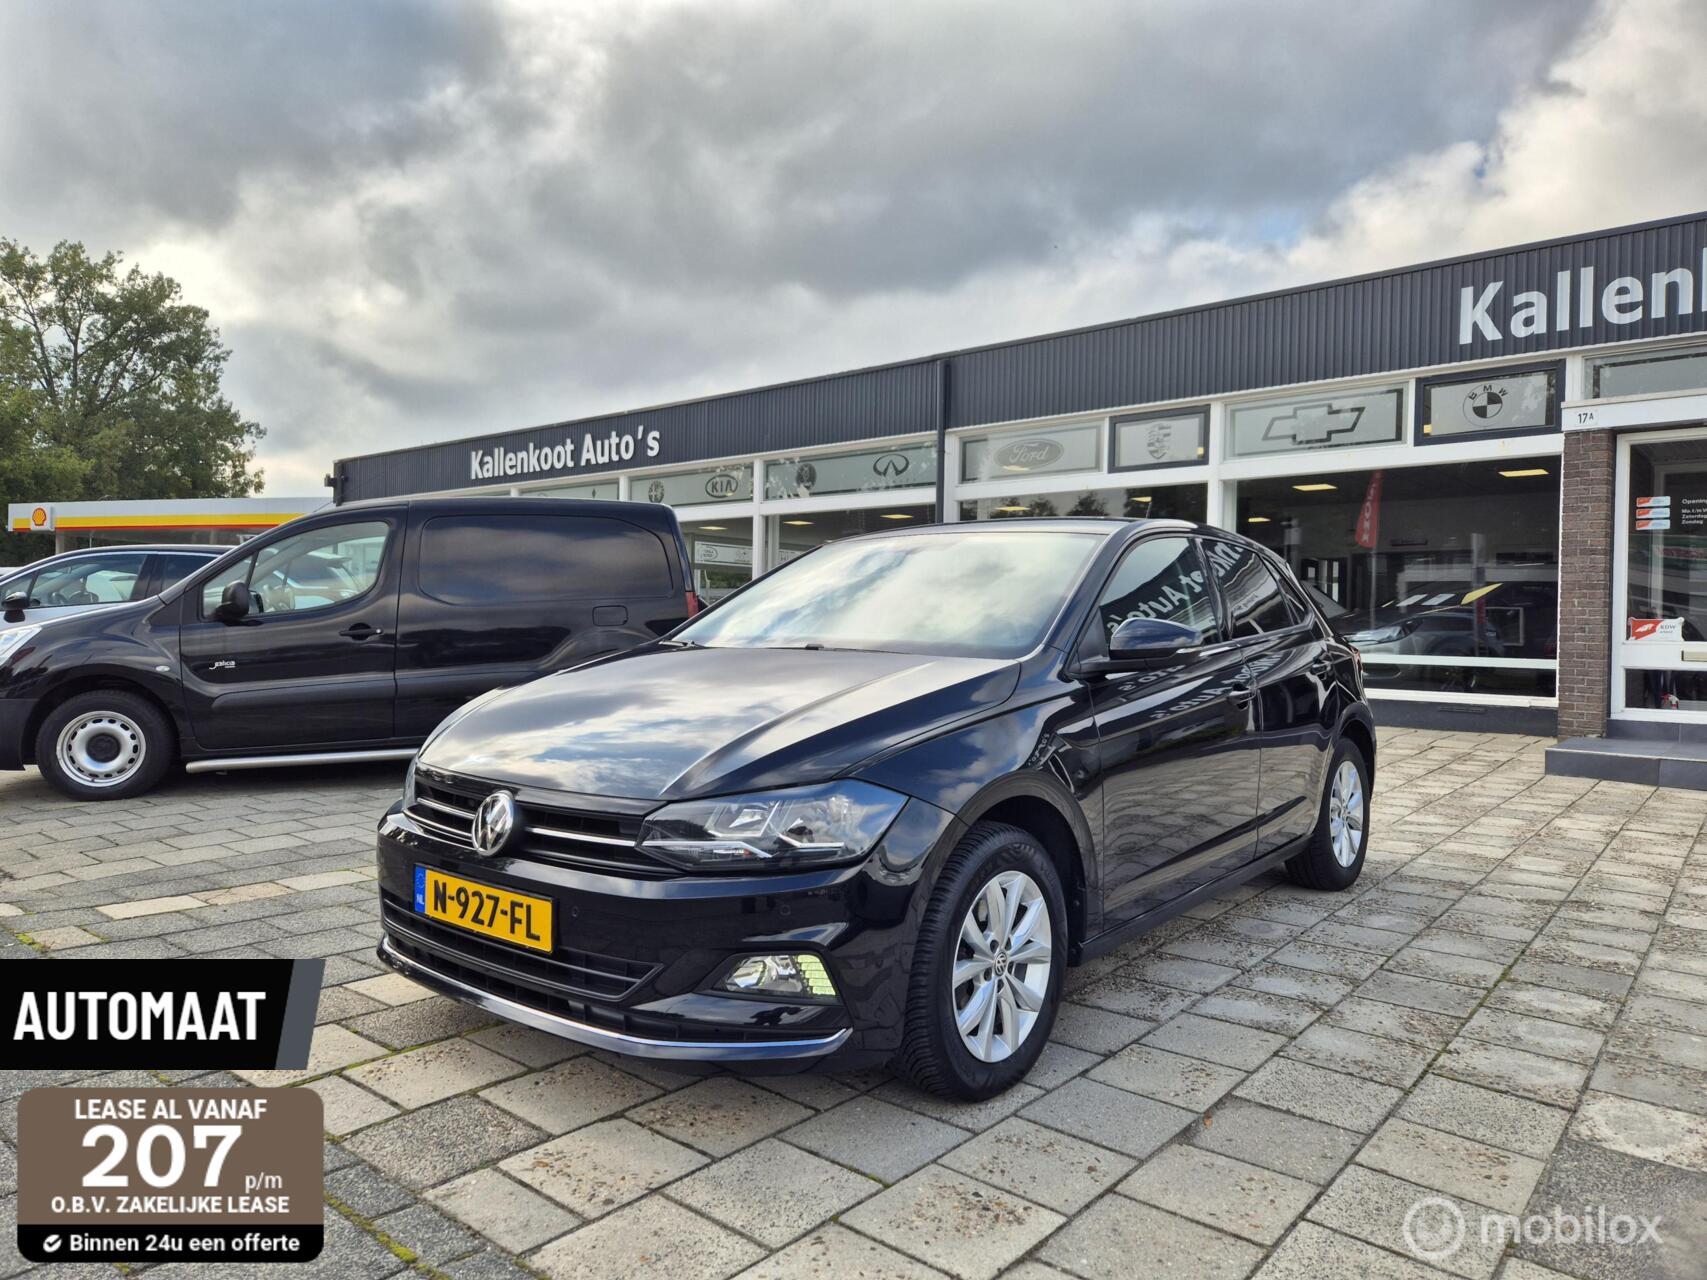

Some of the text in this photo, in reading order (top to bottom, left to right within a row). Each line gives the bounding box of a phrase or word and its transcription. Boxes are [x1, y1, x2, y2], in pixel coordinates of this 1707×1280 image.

[471, 425, 660, 480] Kallenkoot Auto's
[1008, 443, 1049, 464] Ford
[711, 479, 736, 493] KIA
[433, 879, 541, 942] N-927-FL
